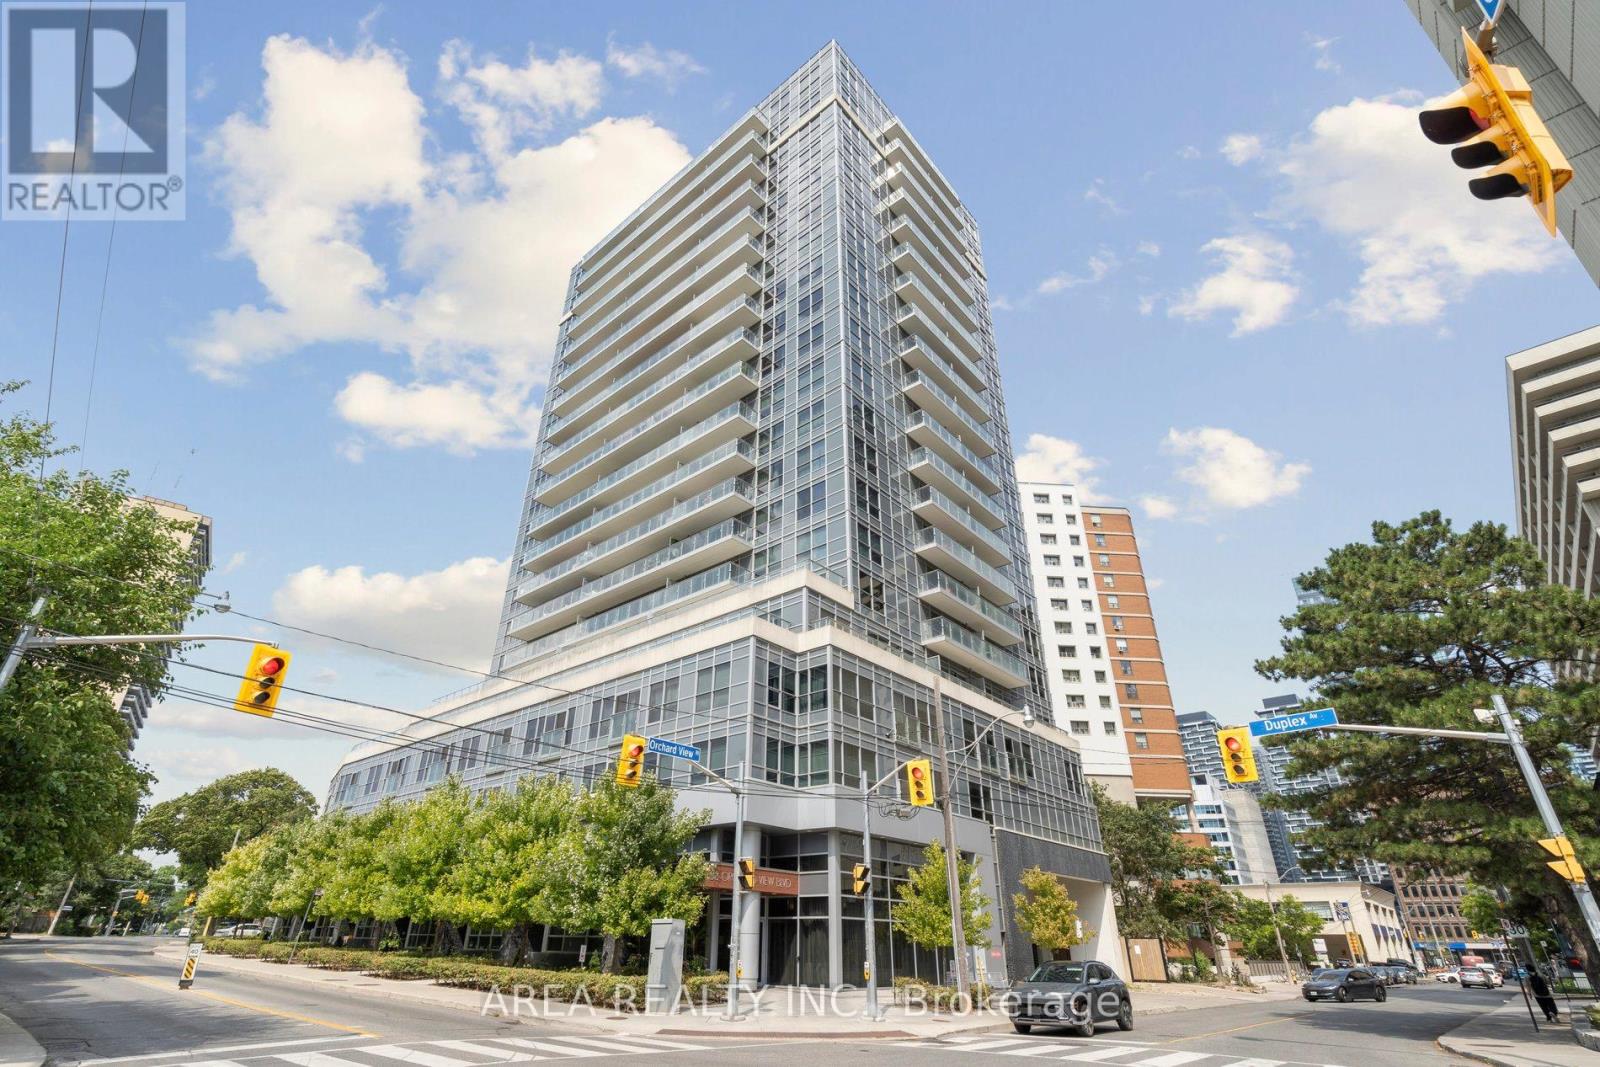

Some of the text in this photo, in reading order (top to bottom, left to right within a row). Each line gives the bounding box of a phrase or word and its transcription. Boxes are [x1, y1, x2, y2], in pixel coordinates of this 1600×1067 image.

[1264, 716, 1307, 731] Duplex
[650, 740, 694, 758] Orchard View
